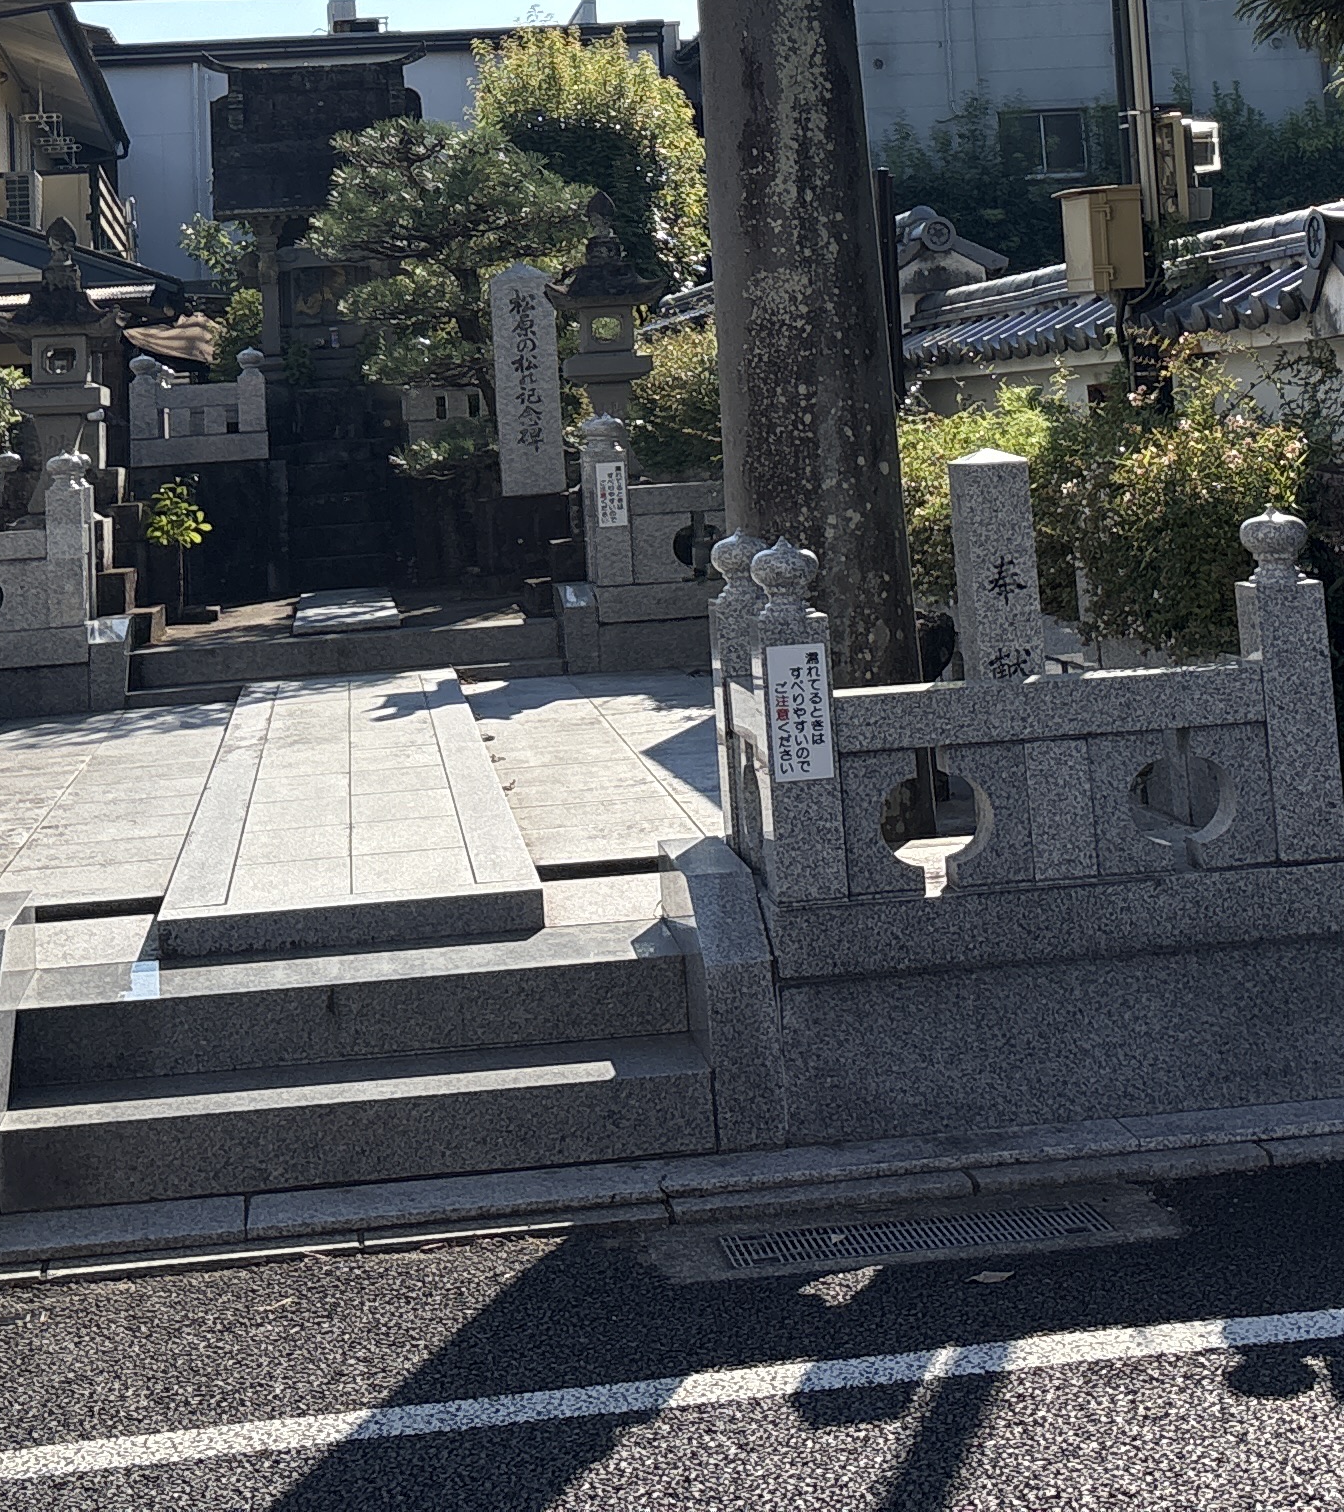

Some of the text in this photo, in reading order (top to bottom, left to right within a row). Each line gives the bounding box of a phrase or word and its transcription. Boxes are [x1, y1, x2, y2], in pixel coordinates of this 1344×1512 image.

[774, 681, 795, 775] ご注意ください
[789, 667, 811, 774] すべりやすいので
[805, 652, 826, 745] 濡れてるときは
